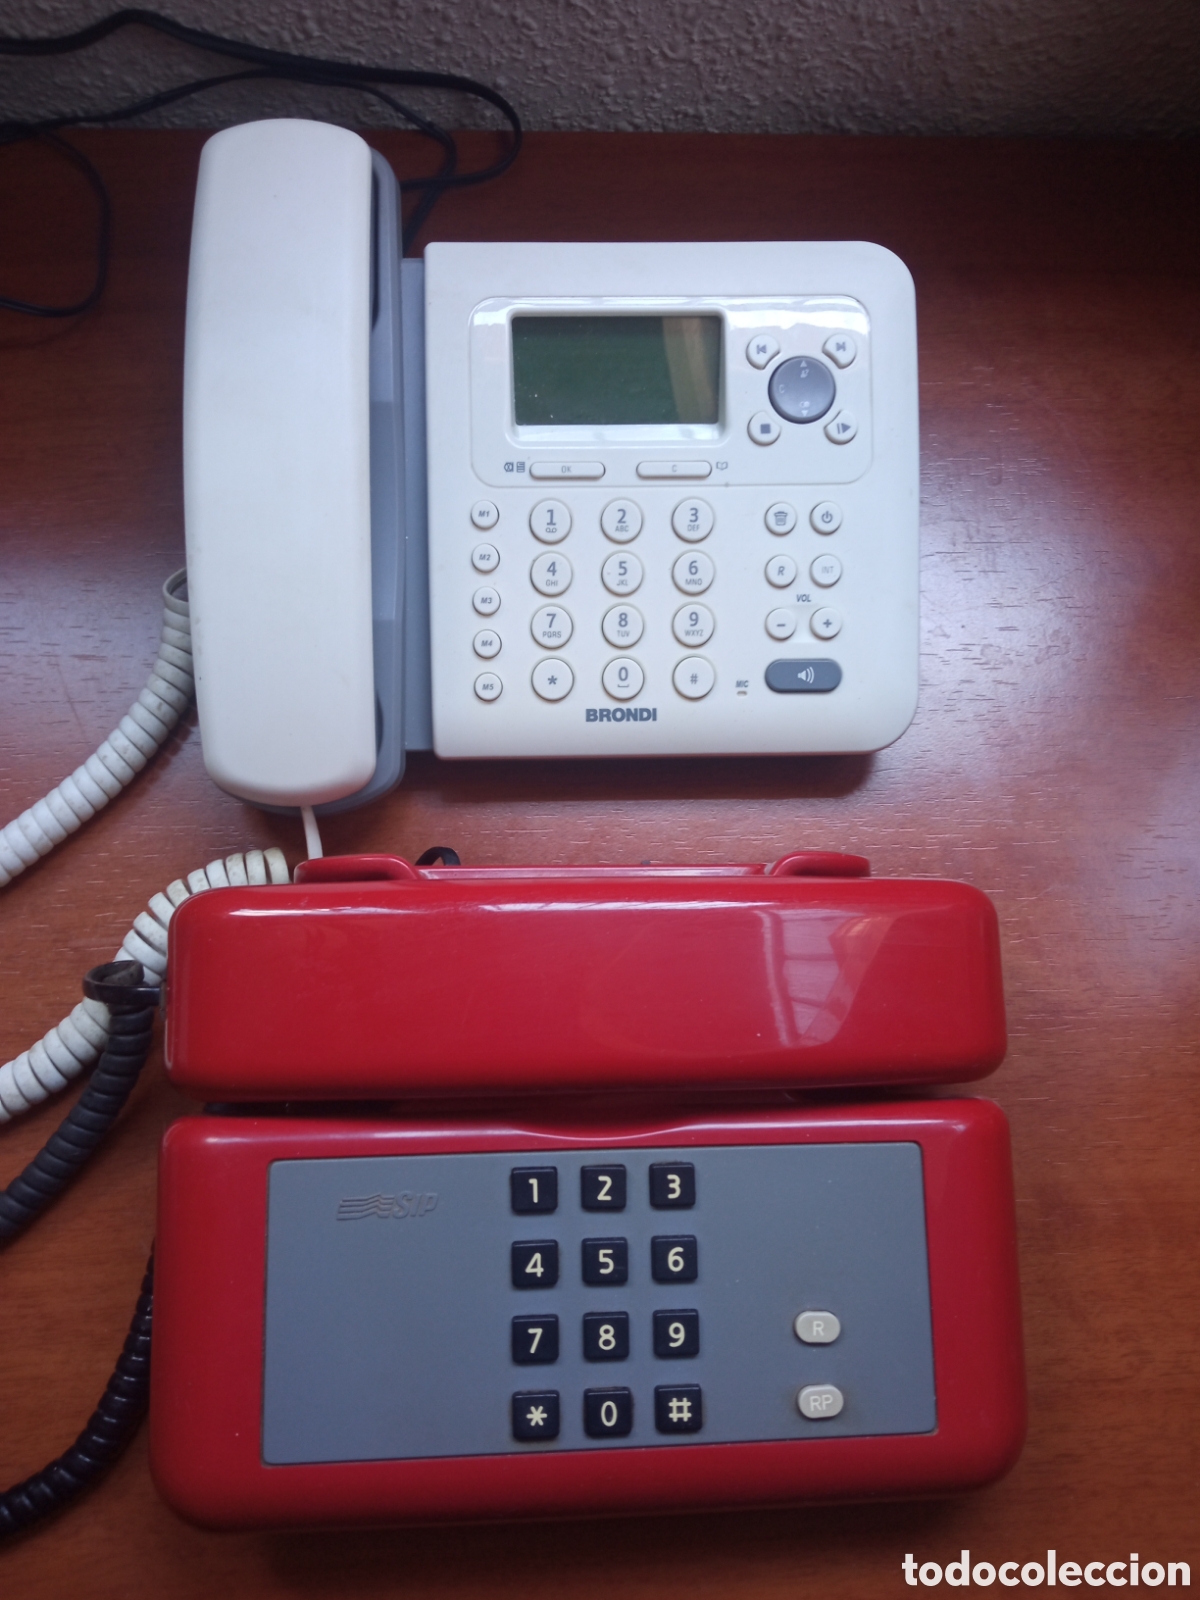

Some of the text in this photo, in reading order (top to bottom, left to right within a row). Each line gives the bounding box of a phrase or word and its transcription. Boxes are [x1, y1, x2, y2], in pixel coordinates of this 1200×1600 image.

[672, 464, 677, 473] C
[546, 509, 557, 526] 1
[617, 509, 626, 524] 2
[689, 508, 699, 523] 3
[547, 562, 557, 576] 4
[618, 561, 627, 576] 5
[689, 561, 698, 575] 6
[778, 566, 785, 576] R
[797, 594, 812, 602] VOL
[546, 613, 556, 628] 7
[619, 613, 628, 627] 8
[689, 612, 699, 627] 9
[684, 629, 704, 637] WXYZ
[619, 667, 628, 681] 0
[585, 708, 657, 722] BRONDI
[529, 1178, 538, 1203] 1
[597, 1175, 612, 1201] 2
[667, 1174, 681, 1199] 3
[392, 1191, 438, 1219] SIP
[525, 1253, 544, 1277] 4
[599, 1250, 614, 1274] 5
[667, 1247, 684, 1272] 6
[668, 1322, 685, 1347] 9
[813, 1321, 825, 1336] R
[528, 1328, 543, 1354] 7
[599, 1324, 616, 1350] 8
[810, 1395, 834, 1411] RP
[601, 1401, 617, 1426] 0
